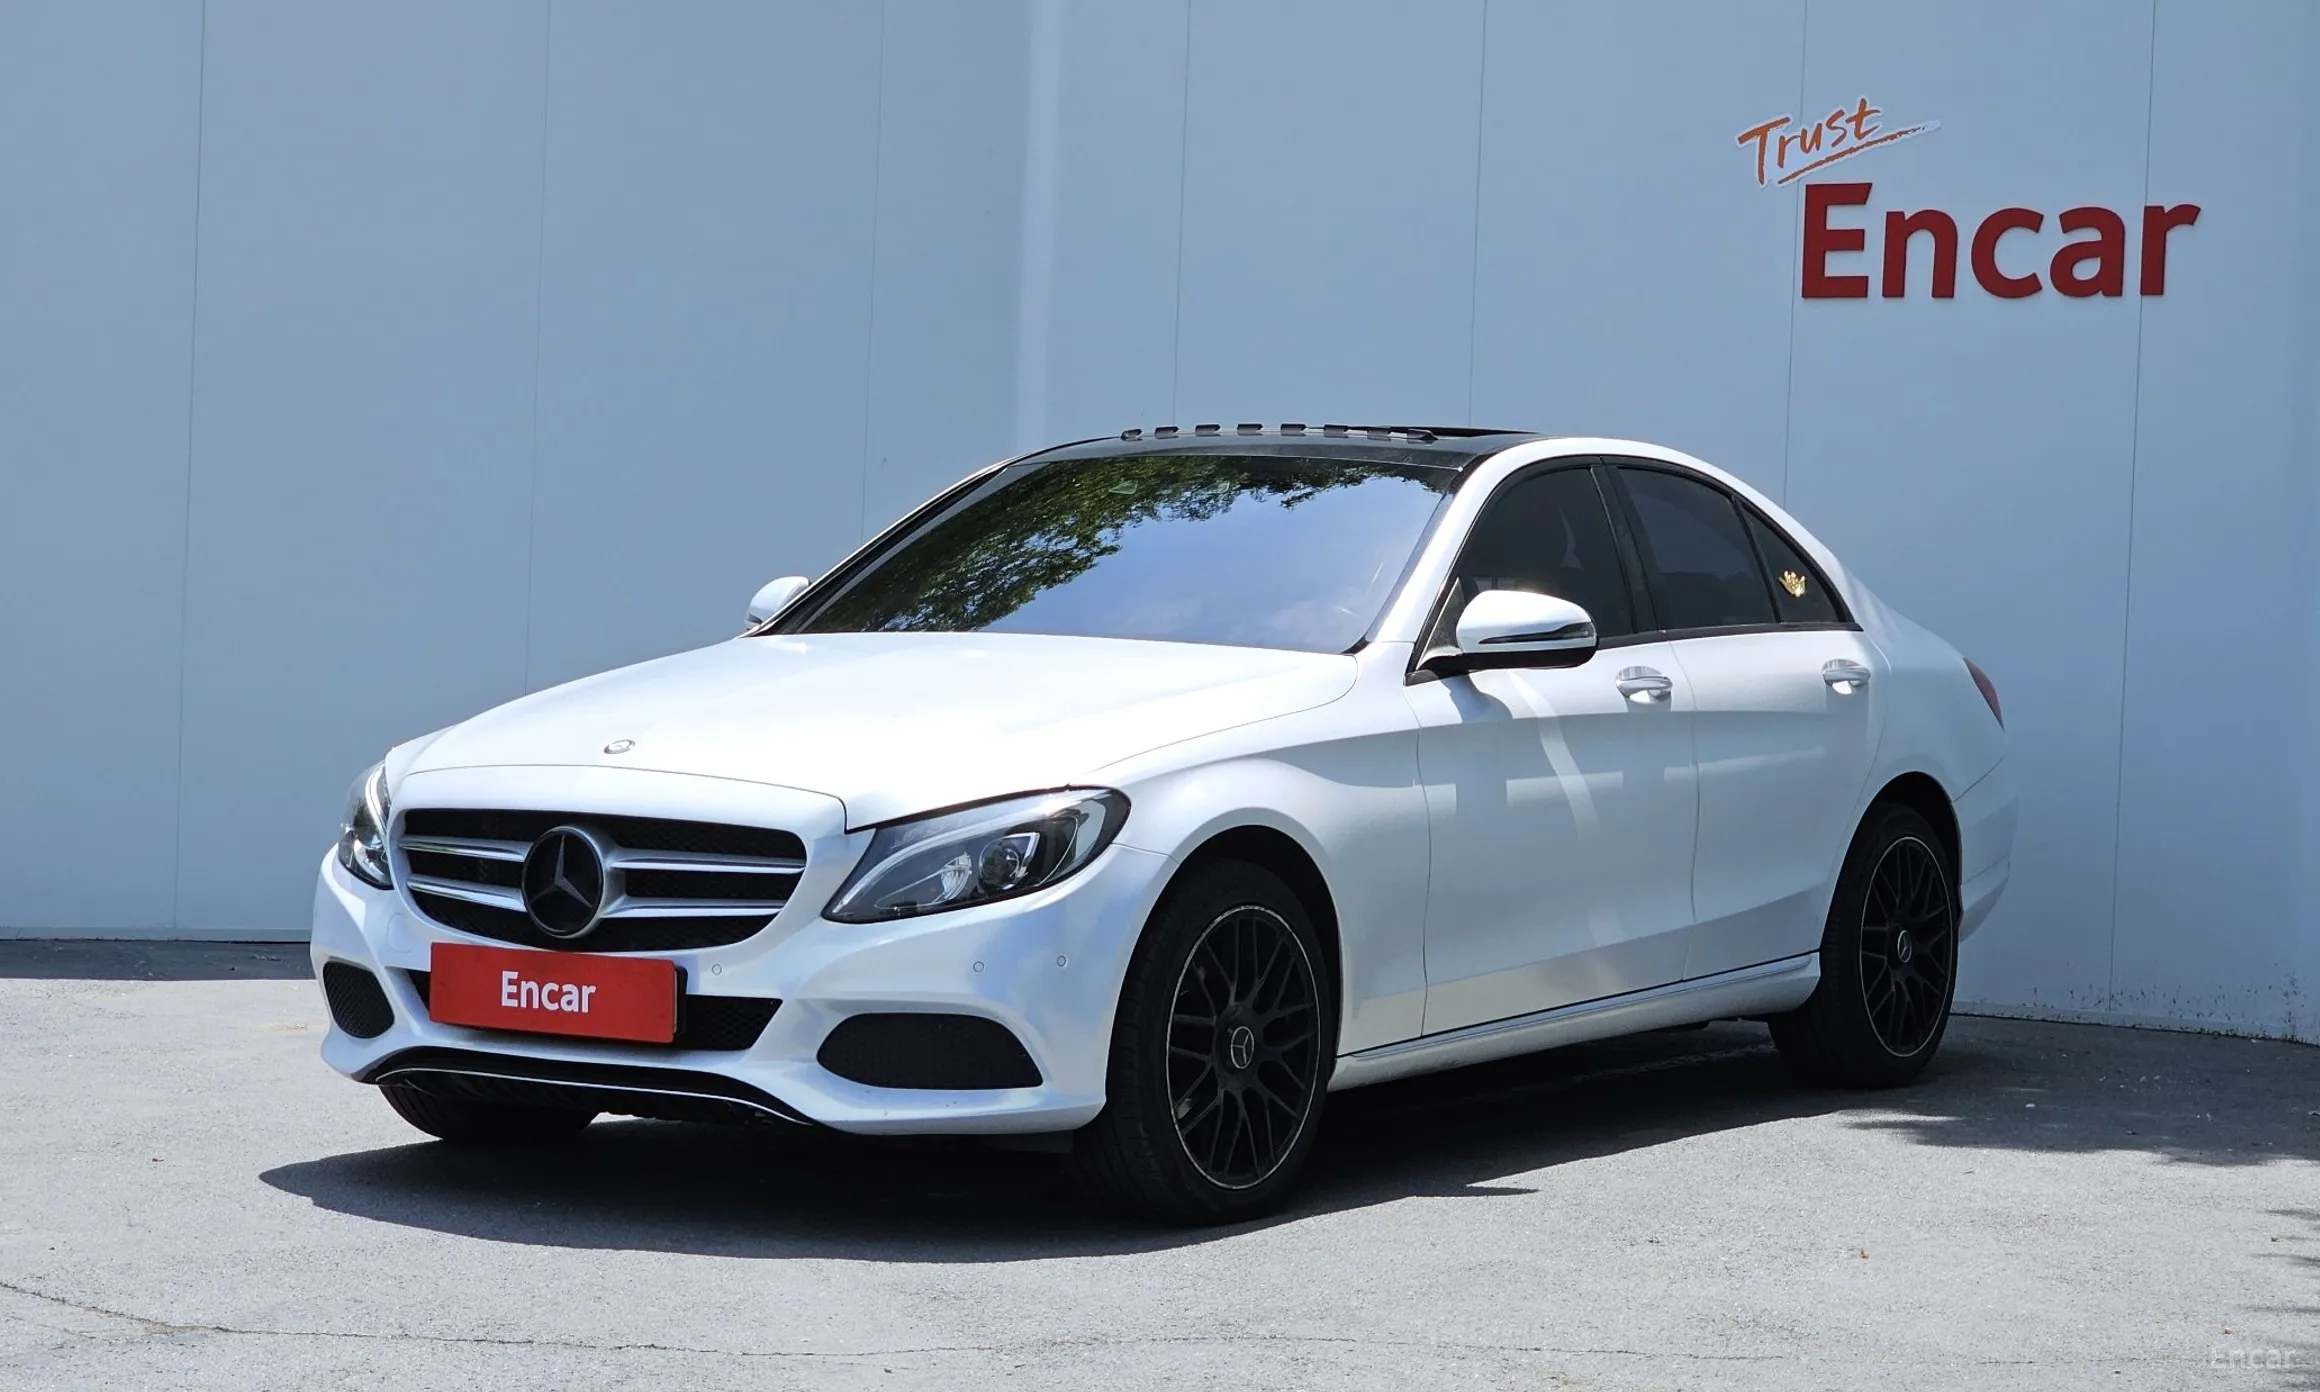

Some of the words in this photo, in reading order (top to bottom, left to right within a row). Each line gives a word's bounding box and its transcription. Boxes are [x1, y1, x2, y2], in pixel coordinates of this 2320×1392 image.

[1737, 97, 1882, 185] Trust
[1801, 182, 2201, 299] Encar
[501, 970, 596, 1013] Encar
